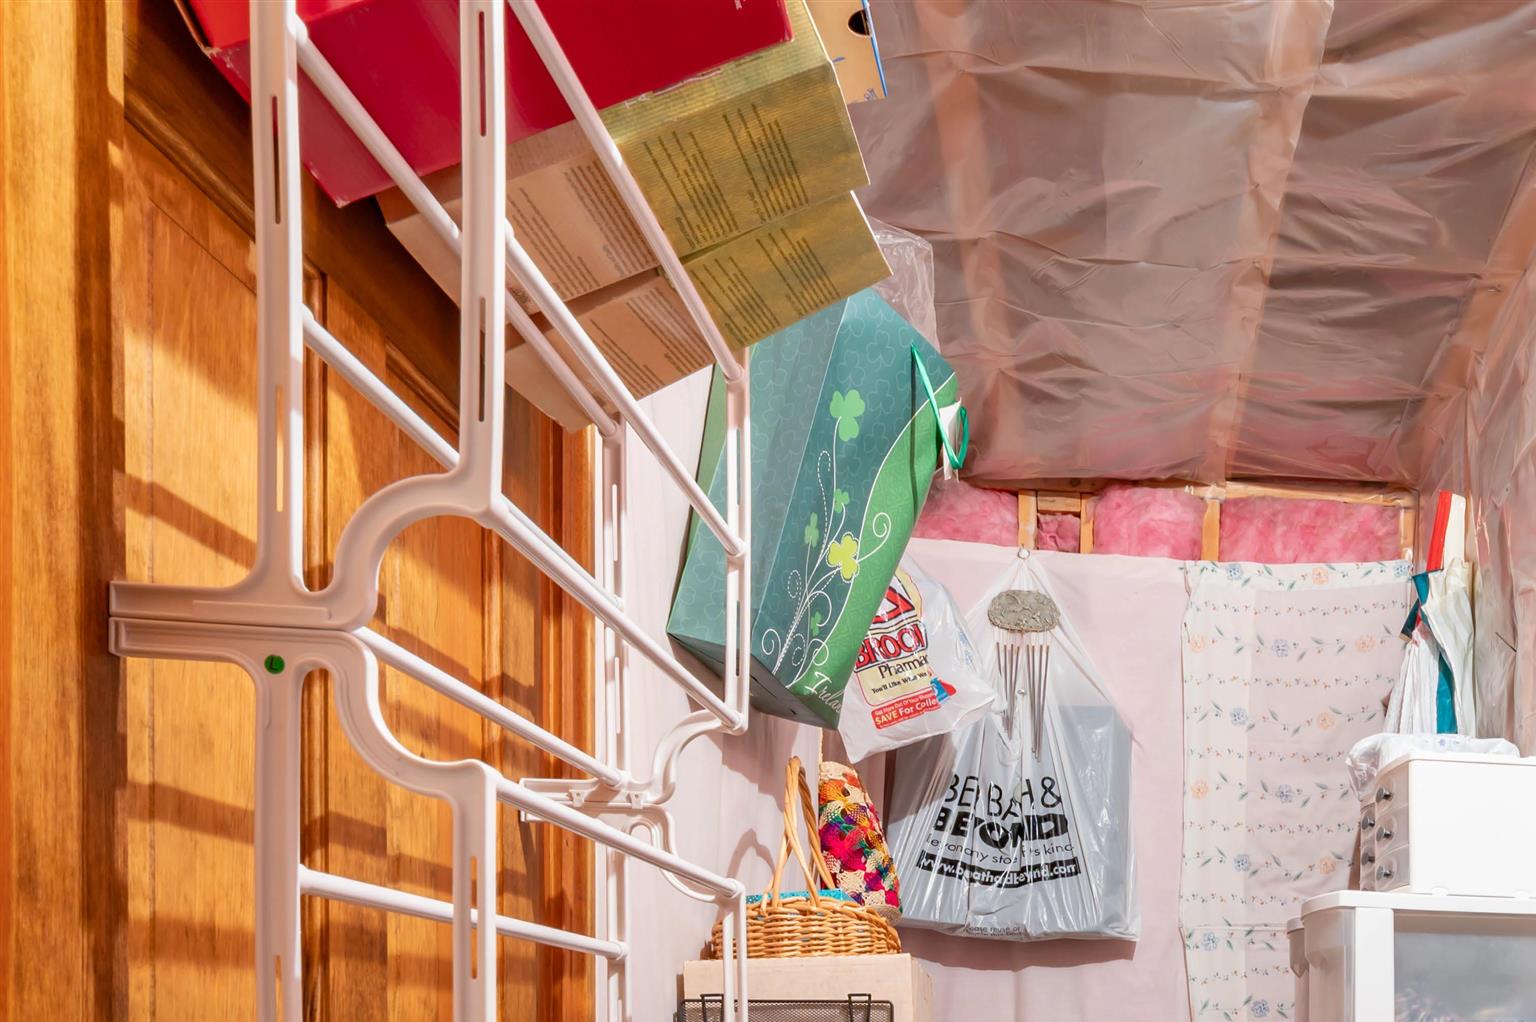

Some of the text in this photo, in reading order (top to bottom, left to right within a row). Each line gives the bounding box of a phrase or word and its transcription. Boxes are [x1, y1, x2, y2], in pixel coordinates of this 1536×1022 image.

[878, 654, 929, 679] Pharma
[875, 710, 899, 725] SAVE
[898, 706, 914, 717] For
[915, 699, 937, 711] Colle
[945, 774, 1063, 820] BE BAH &
[992, 854, 1018, 865] stoe
